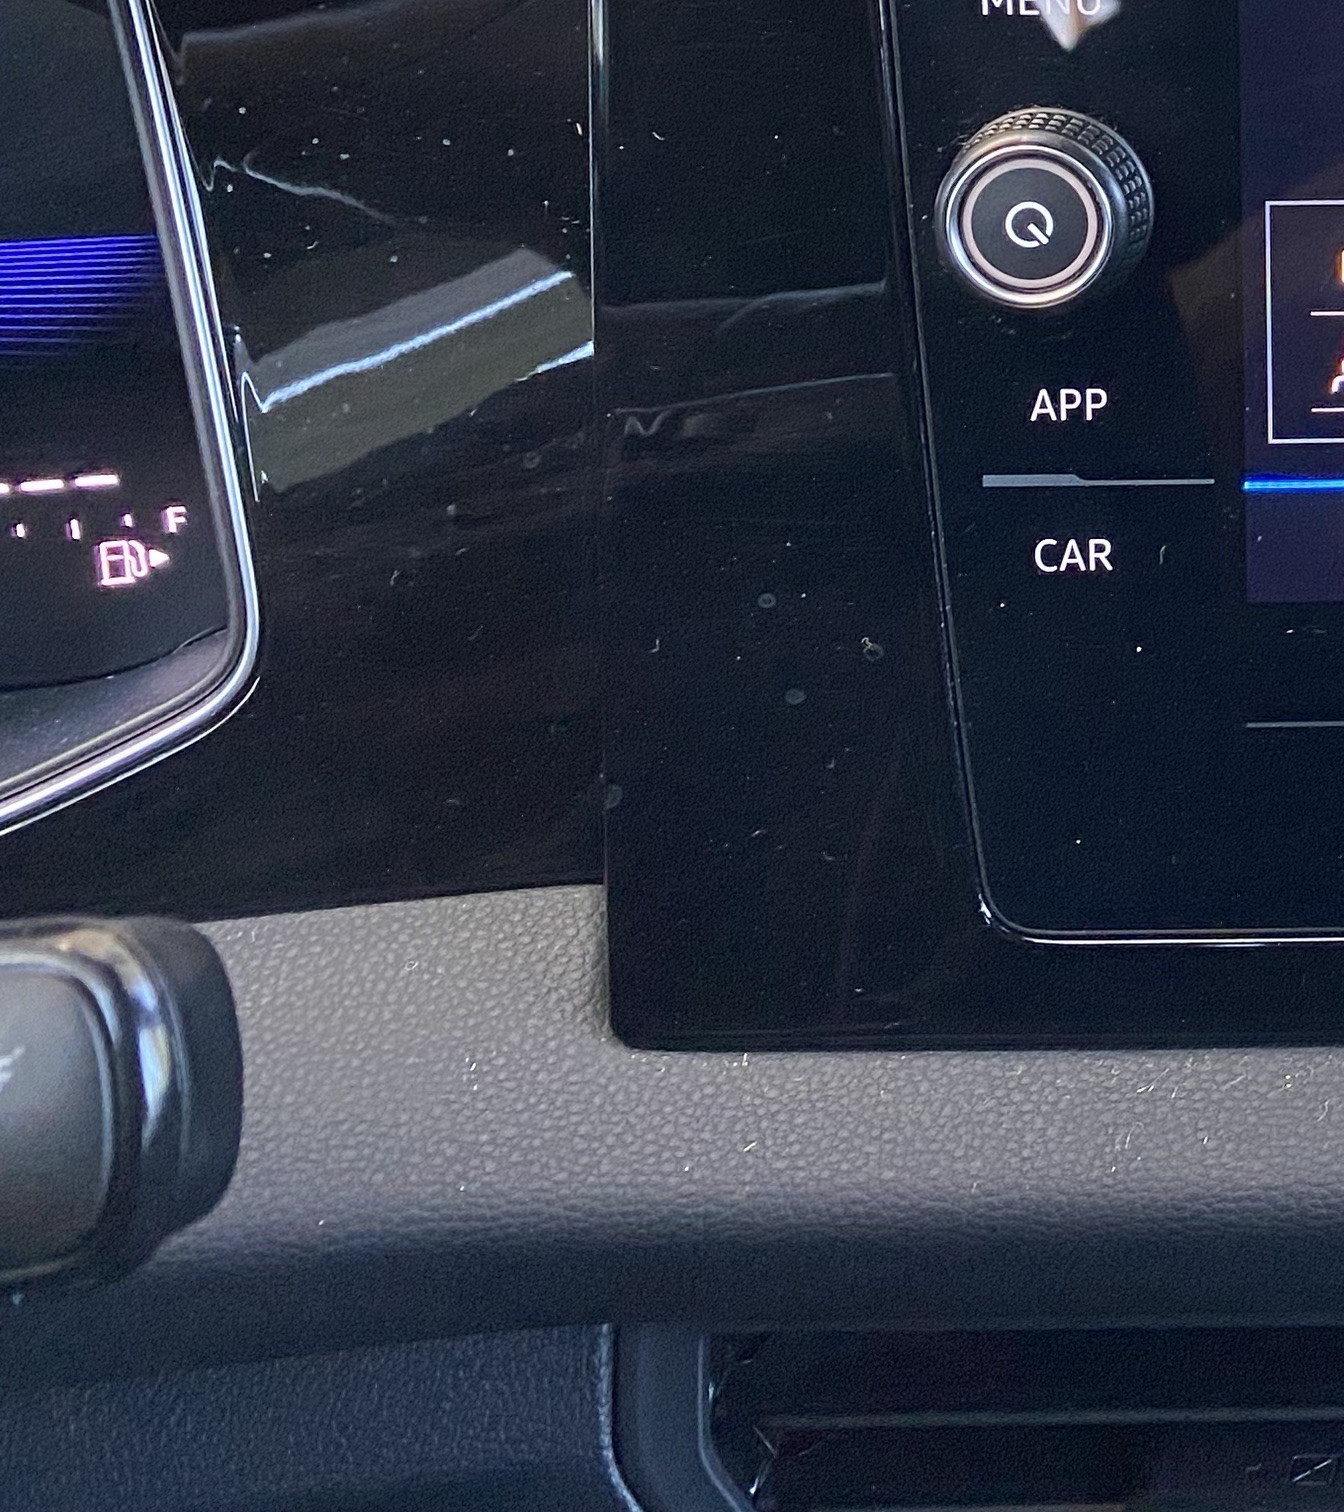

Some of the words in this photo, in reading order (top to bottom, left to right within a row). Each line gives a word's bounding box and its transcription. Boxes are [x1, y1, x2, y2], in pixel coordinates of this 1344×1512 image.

[1029, 388, 1108, 422] APP
[161, 505, 188, 534] F
[1034, 538, 1113, 573] CAR
